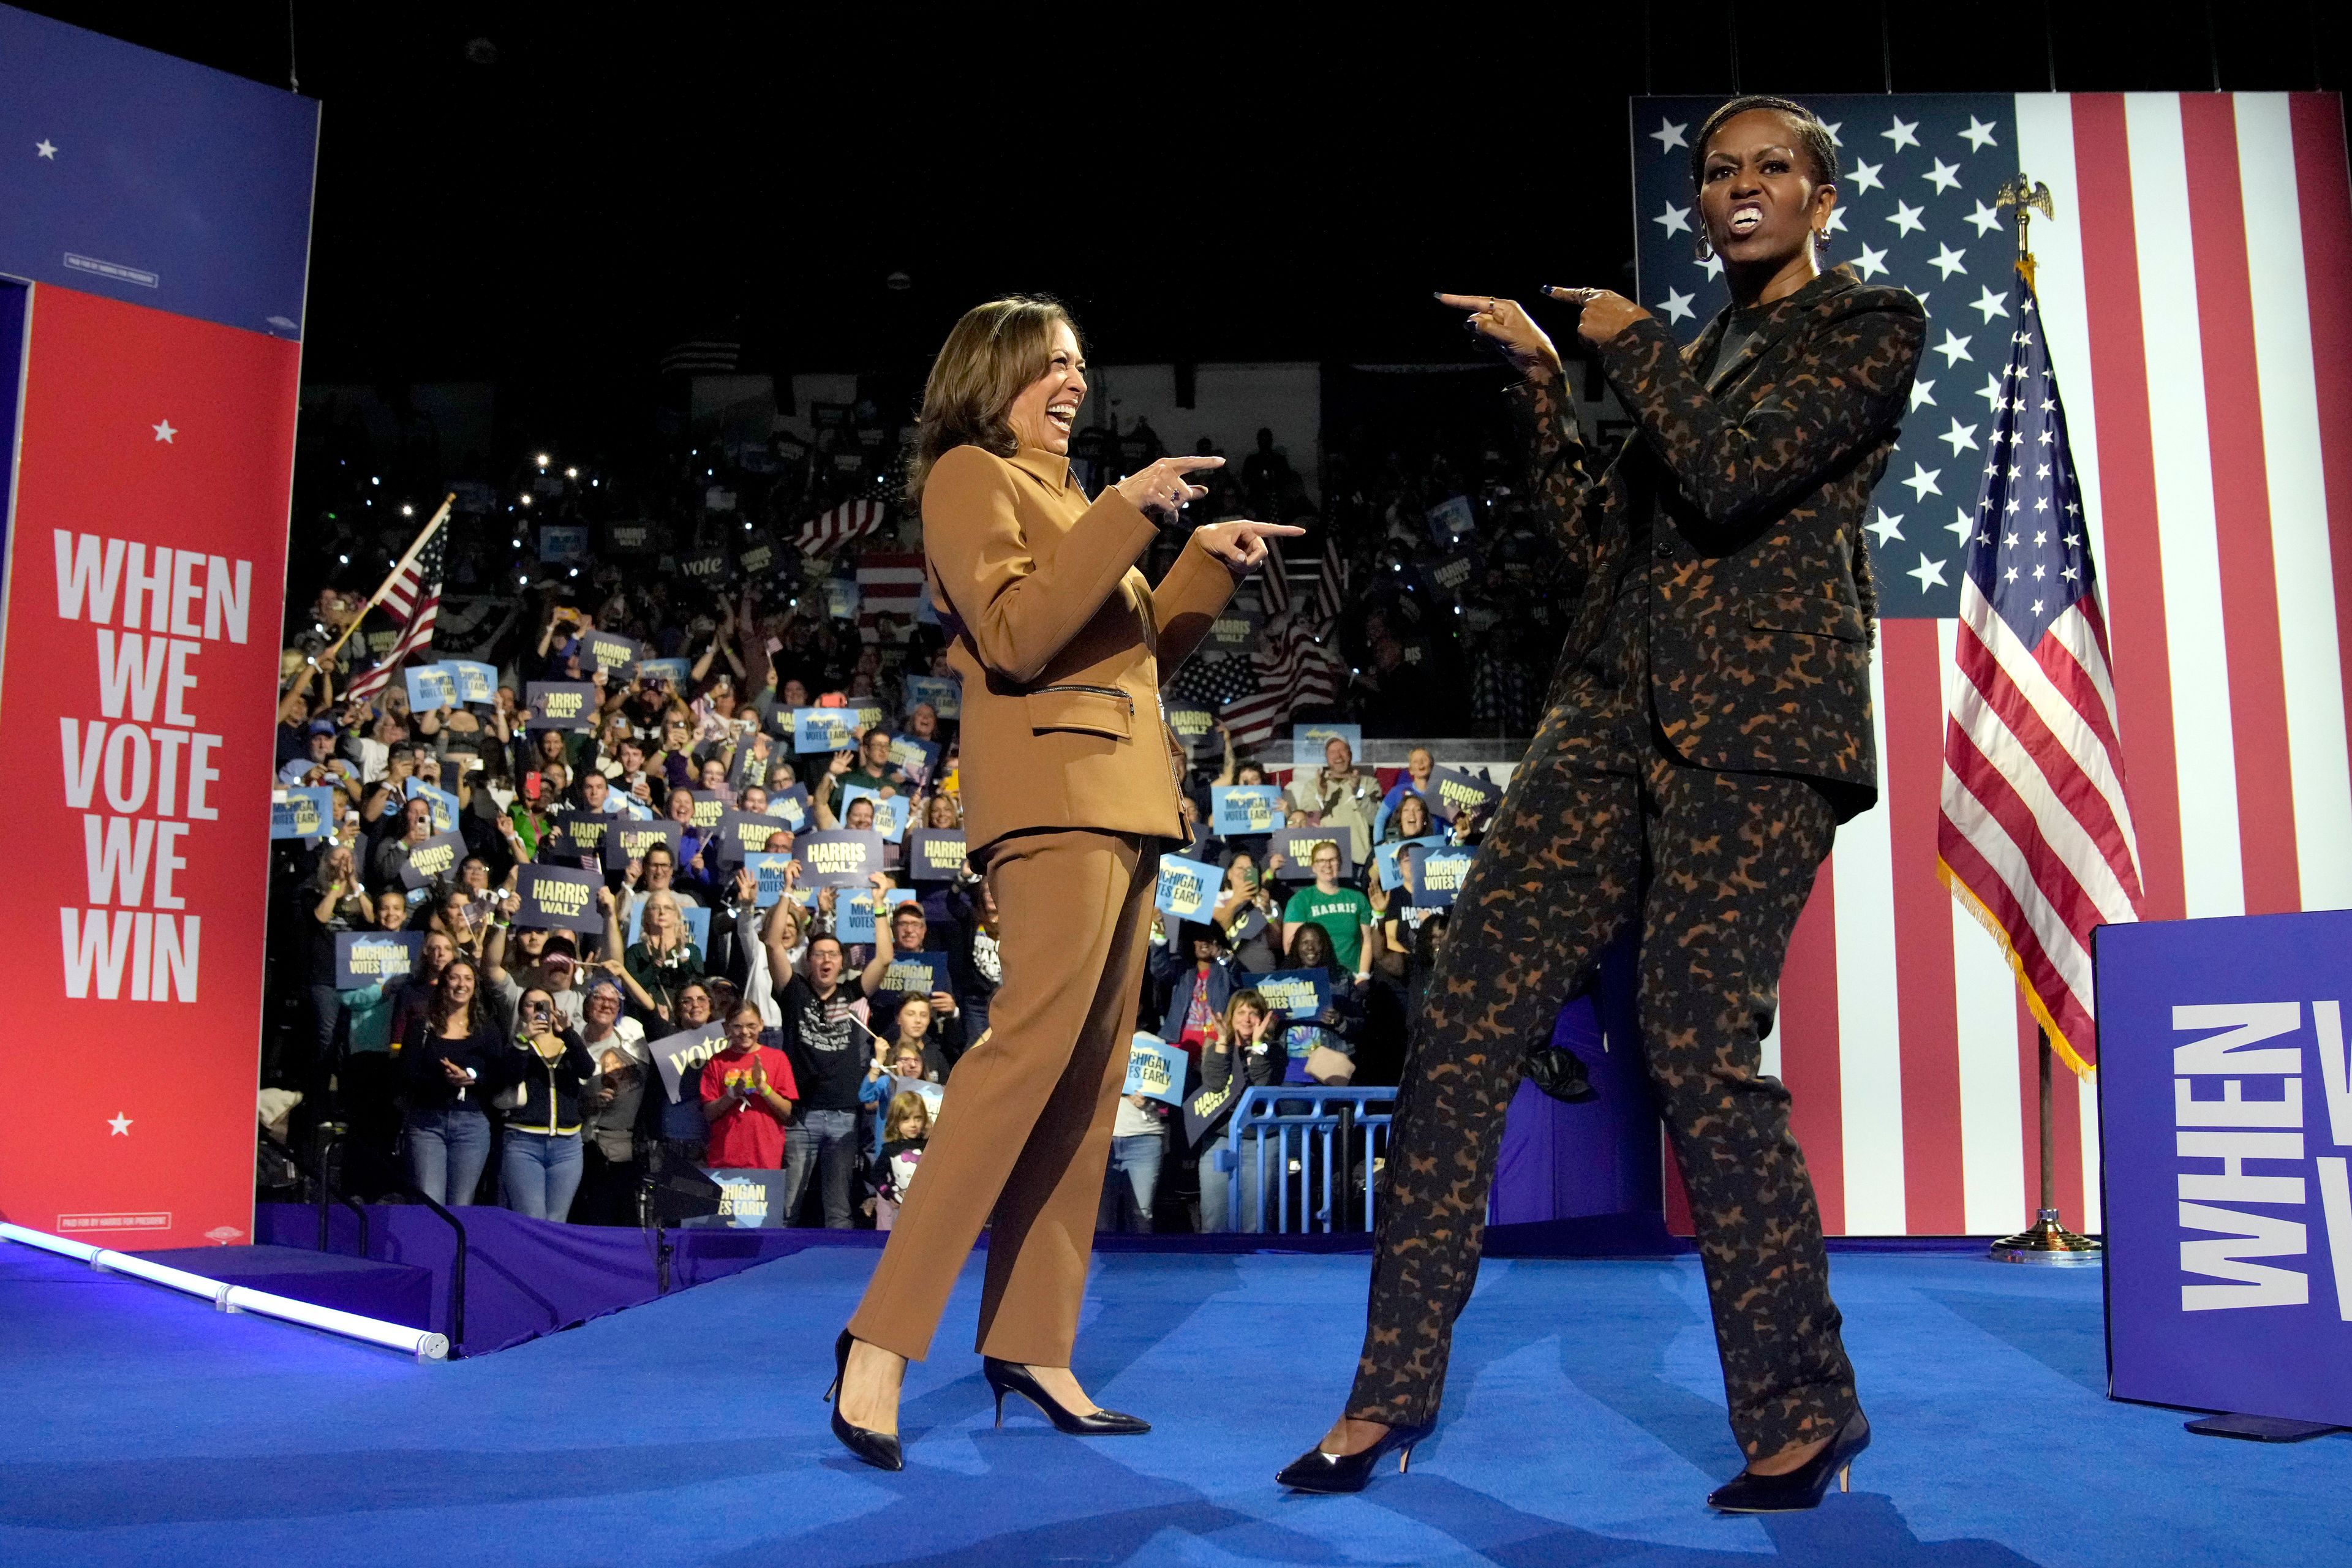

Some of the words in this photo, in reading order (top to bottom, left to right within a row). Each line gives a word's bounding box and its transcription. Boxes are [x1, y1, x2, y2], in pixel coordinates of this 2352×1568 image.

[681, 556, 722, 578] vote
[54, 529, 252, 644] WHEN
[593, 640, 631, 662] HARRIS
[97, 628, 201, 727] WE
[546, 693, 582, 715] ARRIS
[546, 709, 576, 718] WALZ
[1170, 710, 1213, 728] HARRIS
[1177, 725, 1208, 736] WALZ
[59, 717, 223, 821] VOTE
[692, 801, 723, 818] RRIS
[688, 816, 717, 827] WALZ
[619, 830, 667, 849] HRRIS
[410, 843, 455, 869] HARRIS
[808, 842, 866, 863] HARRIS
[924, 839, 967, 859] HARRIS
[83, 813, 189, 910] WE
[418, 861, 452, 876] WALZ
[816, 861, 858, 874] WALZ
[930, 858, 962, 870] WALZ
[759, 880, 785, 892] VOTES
[1158, 867, 1204, 892] ICHIGAN
[1424, 875, 1455, 891] VOTES
[532, 878, 590, 906] HARRIS
[1174, 887, 1203, 906] EARLY
[540, 900, 581, 916] WALZ
[1311, 903, 1358, 918] HARRIS
[850, 916, 876, 929] VOTES
[59, 907, 201, 1003] WIN
[351, 944, 409, 961] MICHIGAN
[349, 960, 381, 974] VOTES
[381, 959, 411, 974] EARLY
[886, 964, 933, 981] ICHIGAN
[880, 978, 903, 991] OTES
[903, 980, 935, 994] EARLY
[1257, 981, 1315, 998] MICHIGAN
[1265, 996, 1289, 1010] OTES
[1288, 994, 1319, 1009] EARLY
[668, 1036, 728, 1076] vote
[1128, 1050, 1171, 1073] CHIGAN
[1143, 1068, 1172, 1086] EARLY
[1201, 1084, 1230, 1118] WALZ
[2172, 1001, 2309, 1311] WHEN
[722, 1184, 766, 1201] CHIGAN
[733, 1200, 769, 1216] EARLY
